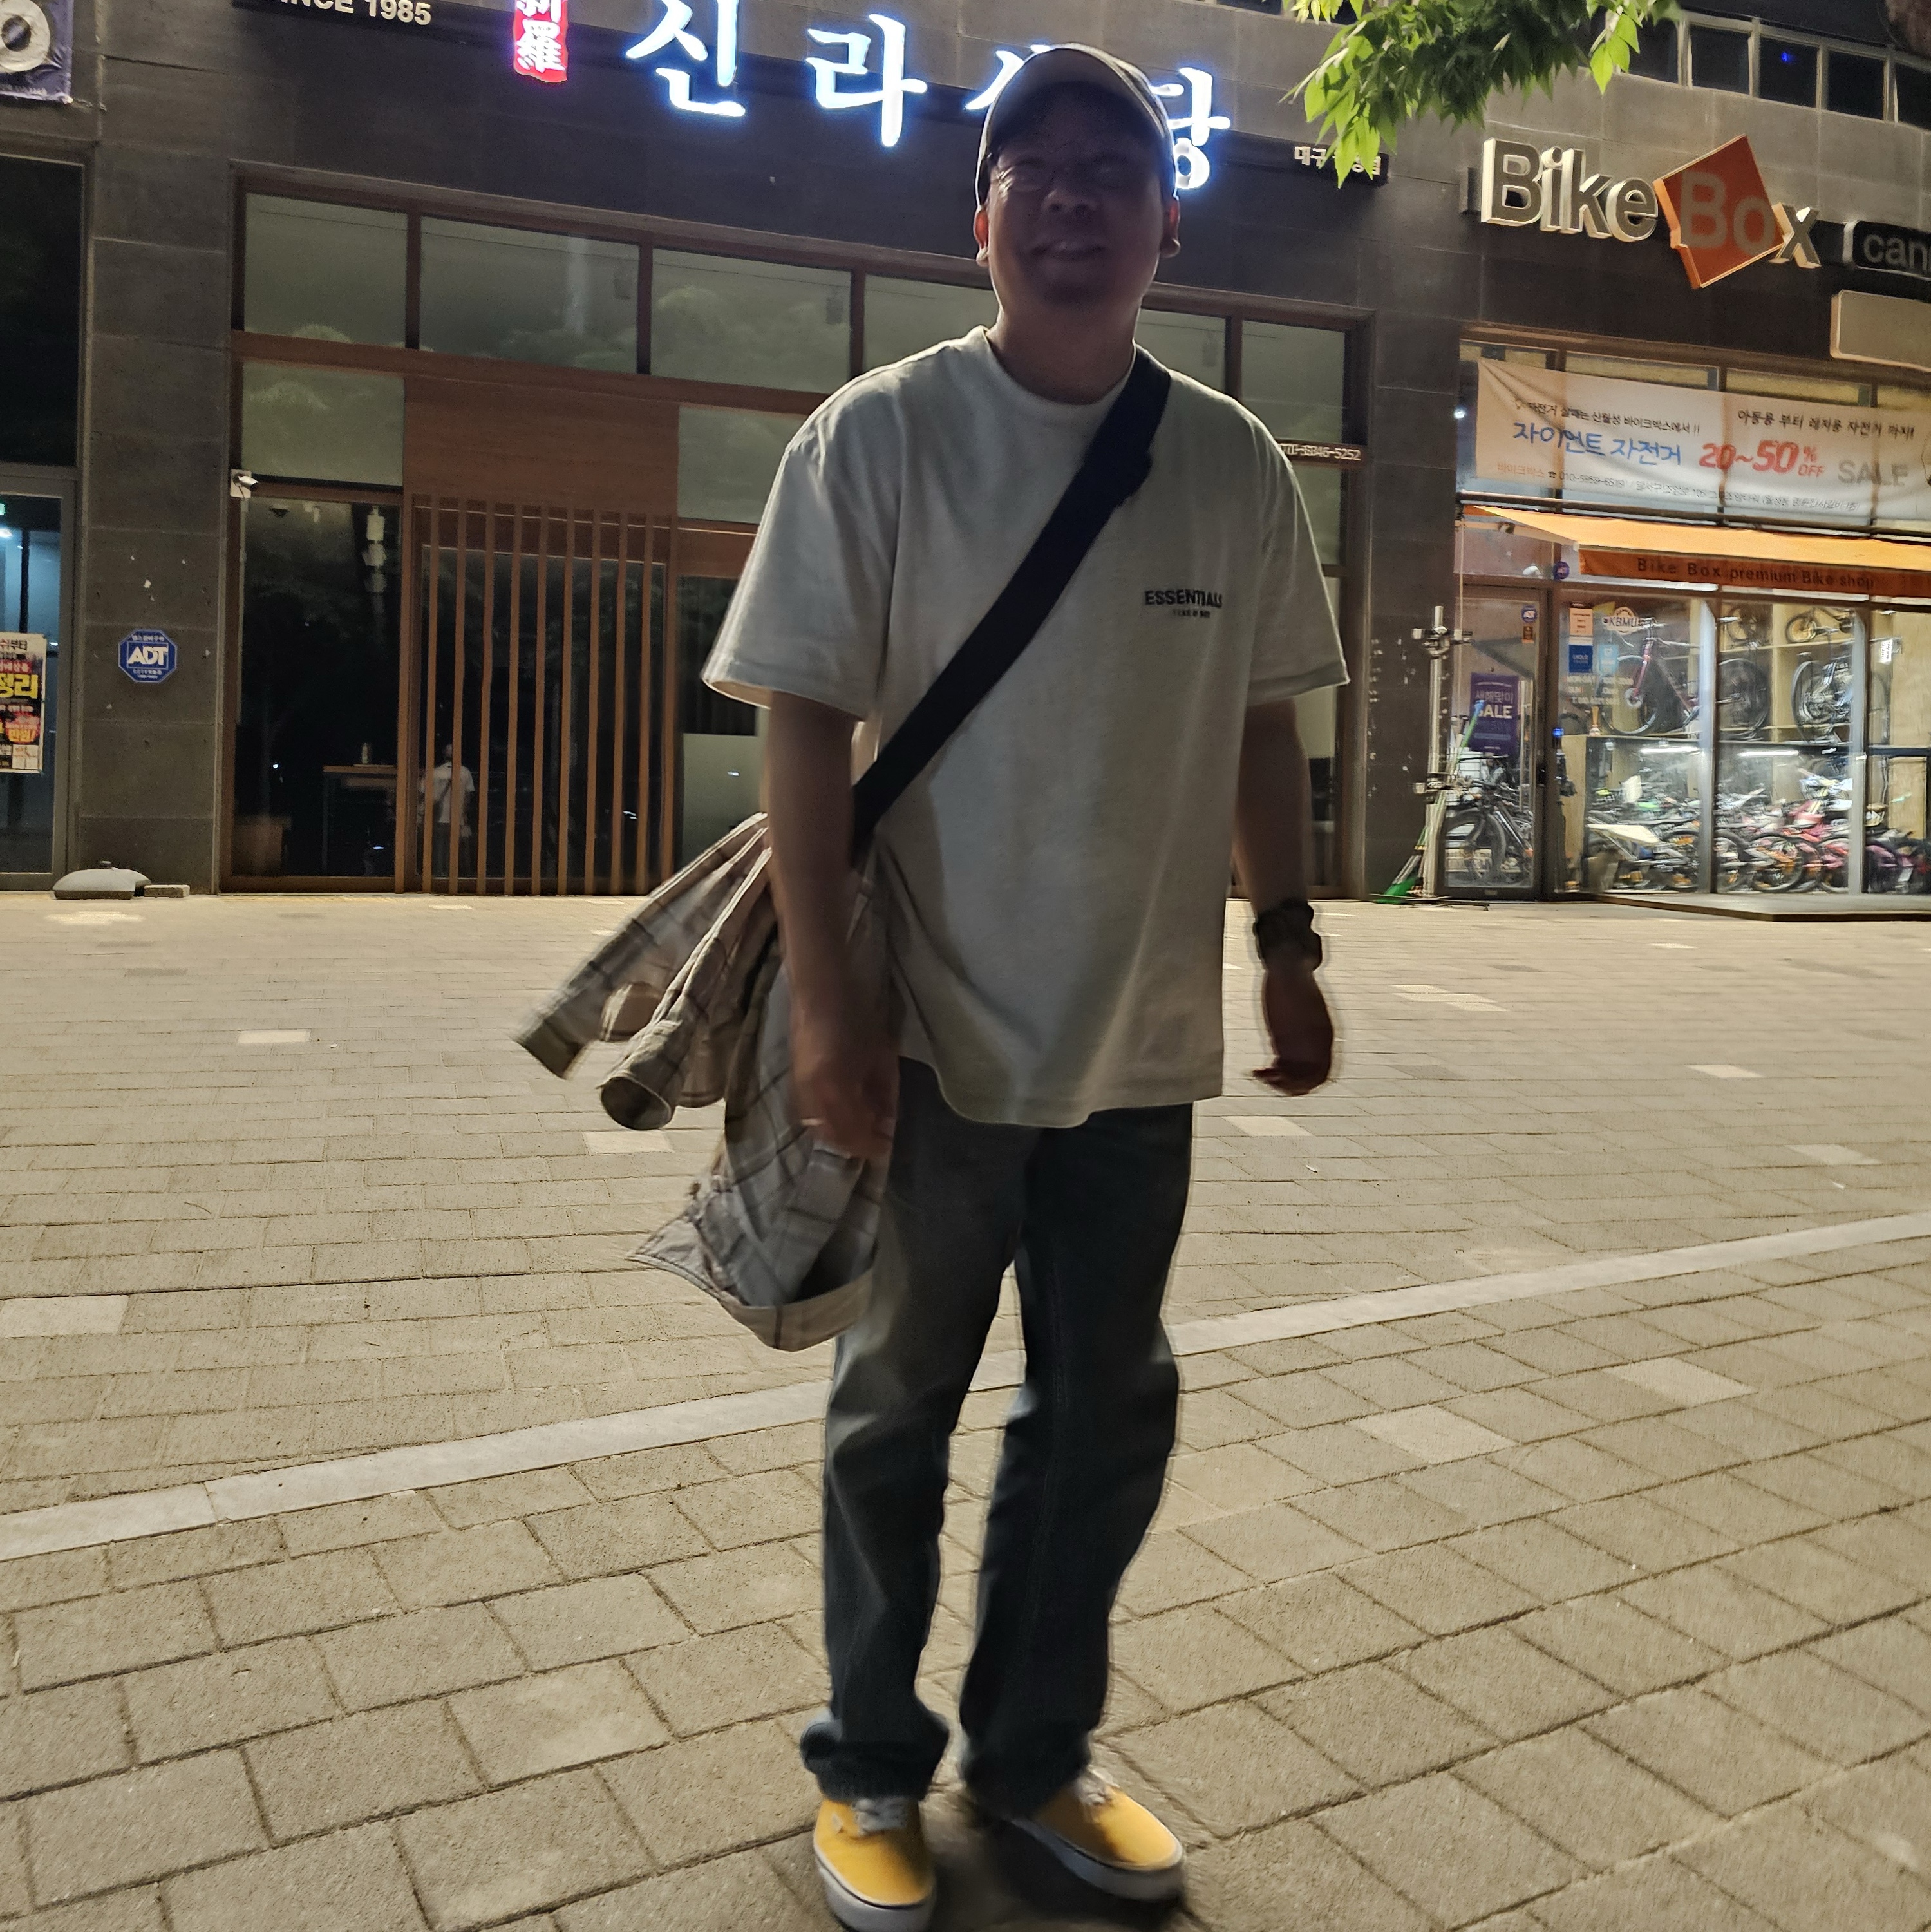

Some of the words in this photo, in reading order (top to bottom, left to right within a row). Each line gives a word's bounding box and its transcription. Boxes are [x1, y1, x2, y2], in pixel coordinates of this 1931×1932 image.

[365, 0, 431, 26] 1985
[1480, 137, 1659, 243] Bike
[1679, 169, 1822, 268] Box
[1863, 233, 1931, 274] can
[1514, 422, 1606, 457] 자이언트
[1610, 438, 1682, 466] 자전거
[1838, 458, 1910, 487] SALE
[1637, 558, 1677, 574] Bike
[1687, 562, 1721, 578] Box
[1729, 567, 1796, 583] premium
[1802, 570, 1835, 587] Bike
[1839, 573, 1874, 591] shop
[128, 646, 169, 666] ADT
